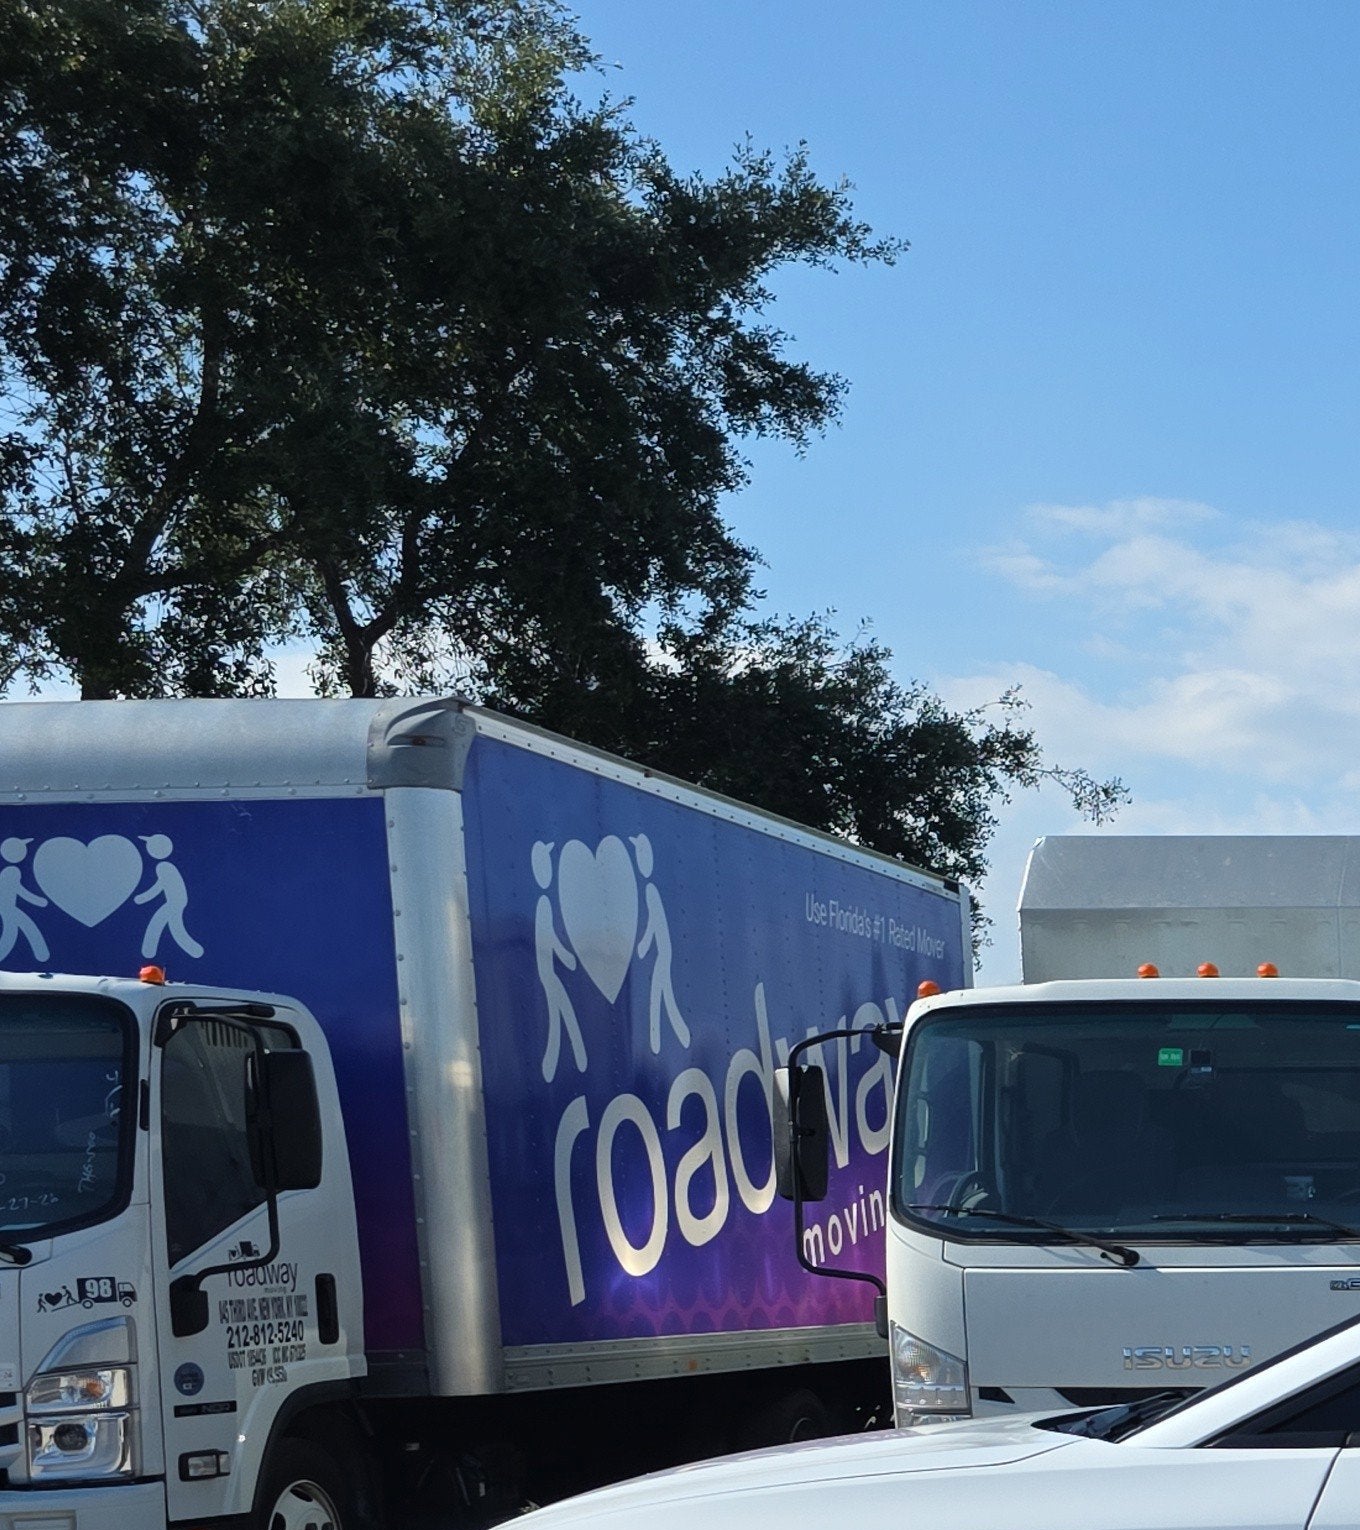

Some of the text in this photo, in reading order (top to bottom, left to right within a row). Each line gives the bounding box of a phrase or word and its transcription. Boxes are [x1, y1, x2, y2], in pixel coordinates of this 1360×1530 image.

[805, 892, 828, 926] Use
[829, 899, 872, 938] Florida's
[888, 918, 916, 951] Rated
[917, 926, 945, 959] Mover
[554, 982, 903, 1307] roadwa
[802, 1184, 889, 1269] movin
[85, 1279, 113, 1299] 98
[226, 1320, 304, 1348] 212-812-5240
[1122, 1344, 1252, 1370] ISUZU
